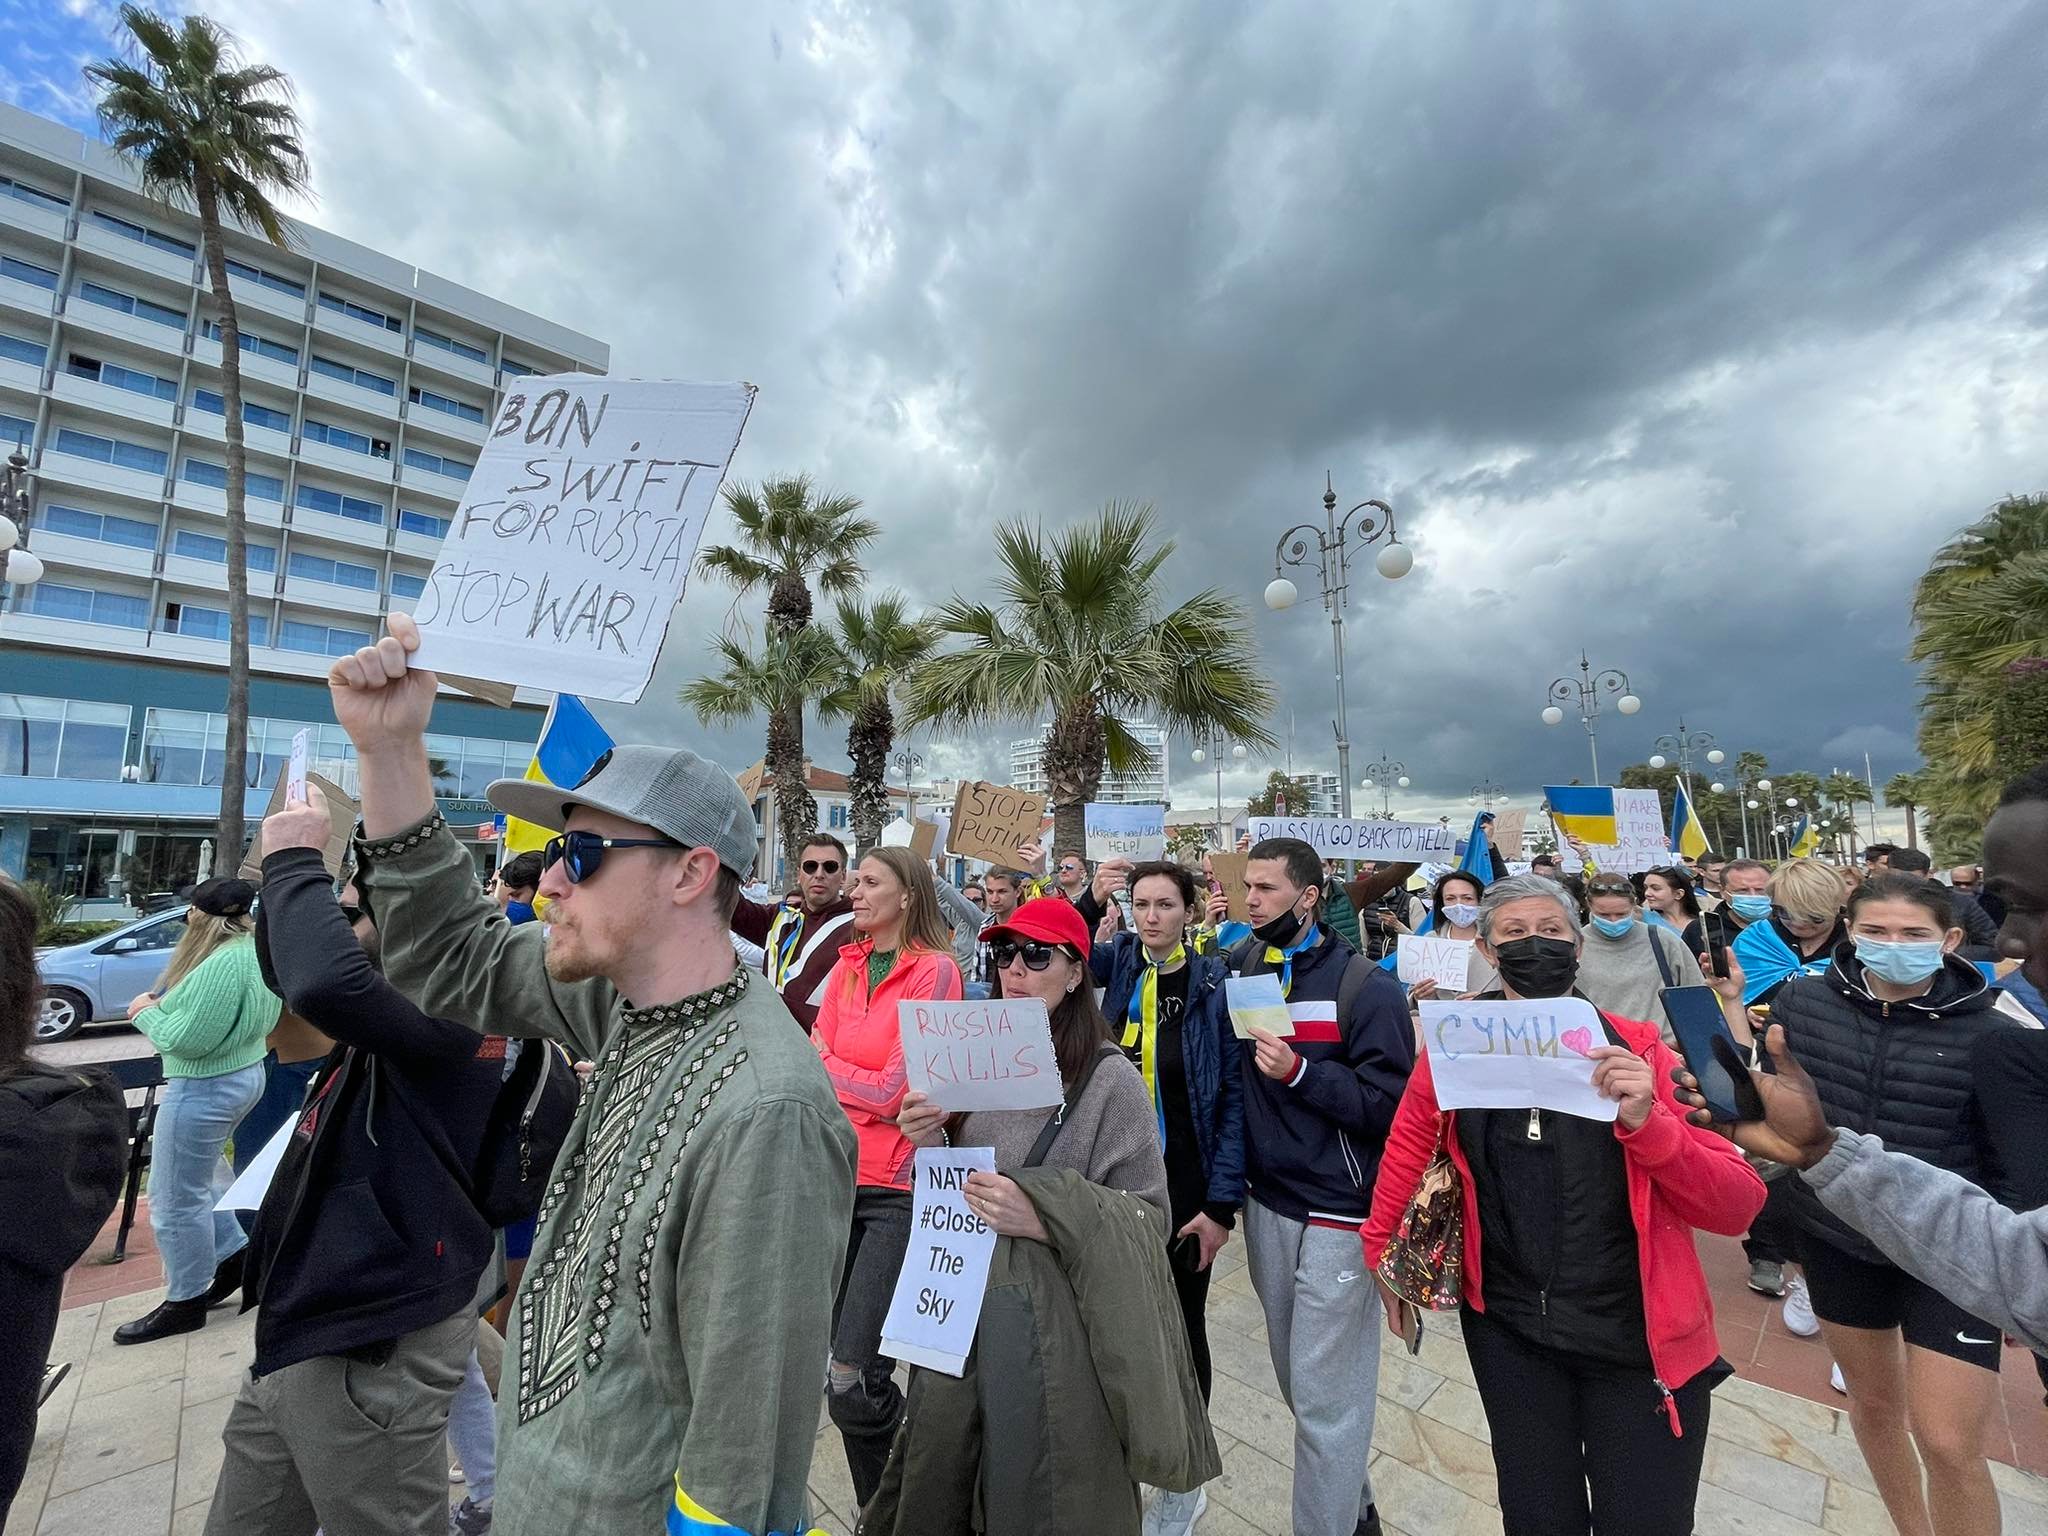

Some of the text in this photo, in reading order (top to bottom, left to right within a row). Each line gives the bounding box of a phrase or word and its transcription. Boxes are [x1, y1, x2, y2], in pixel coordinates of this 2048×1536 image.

[507, 442, 720, 512] SWIFT
[460, 501, 688, 584] FOR RUSSIA
[416, 562, 529, 626] STOP
[448, 801, 498, 812] SUN HAL
[967, 789, 1037, 821] STOP
[1108, 839, 1140, 855] HELP!
[1257, 822, 1450, 851] RUSSIA GO BACK TO HELL
[1597, 851, 1659, 871] WIFT
[1405, 937, 1464, 970] SAVE
[915, 1007, 1012, 1040] RUSSIA
[1436, 1014, 1560, 1060] СУМИ
[924, 1045, 1039, 1088] KILLS
[928, 1166, 978, 1191] NAT
[920, 1205, 988, 1234] #Close
[929, 1246, 964, 1275] The
[916, 1287, 954, 1325] Sky
